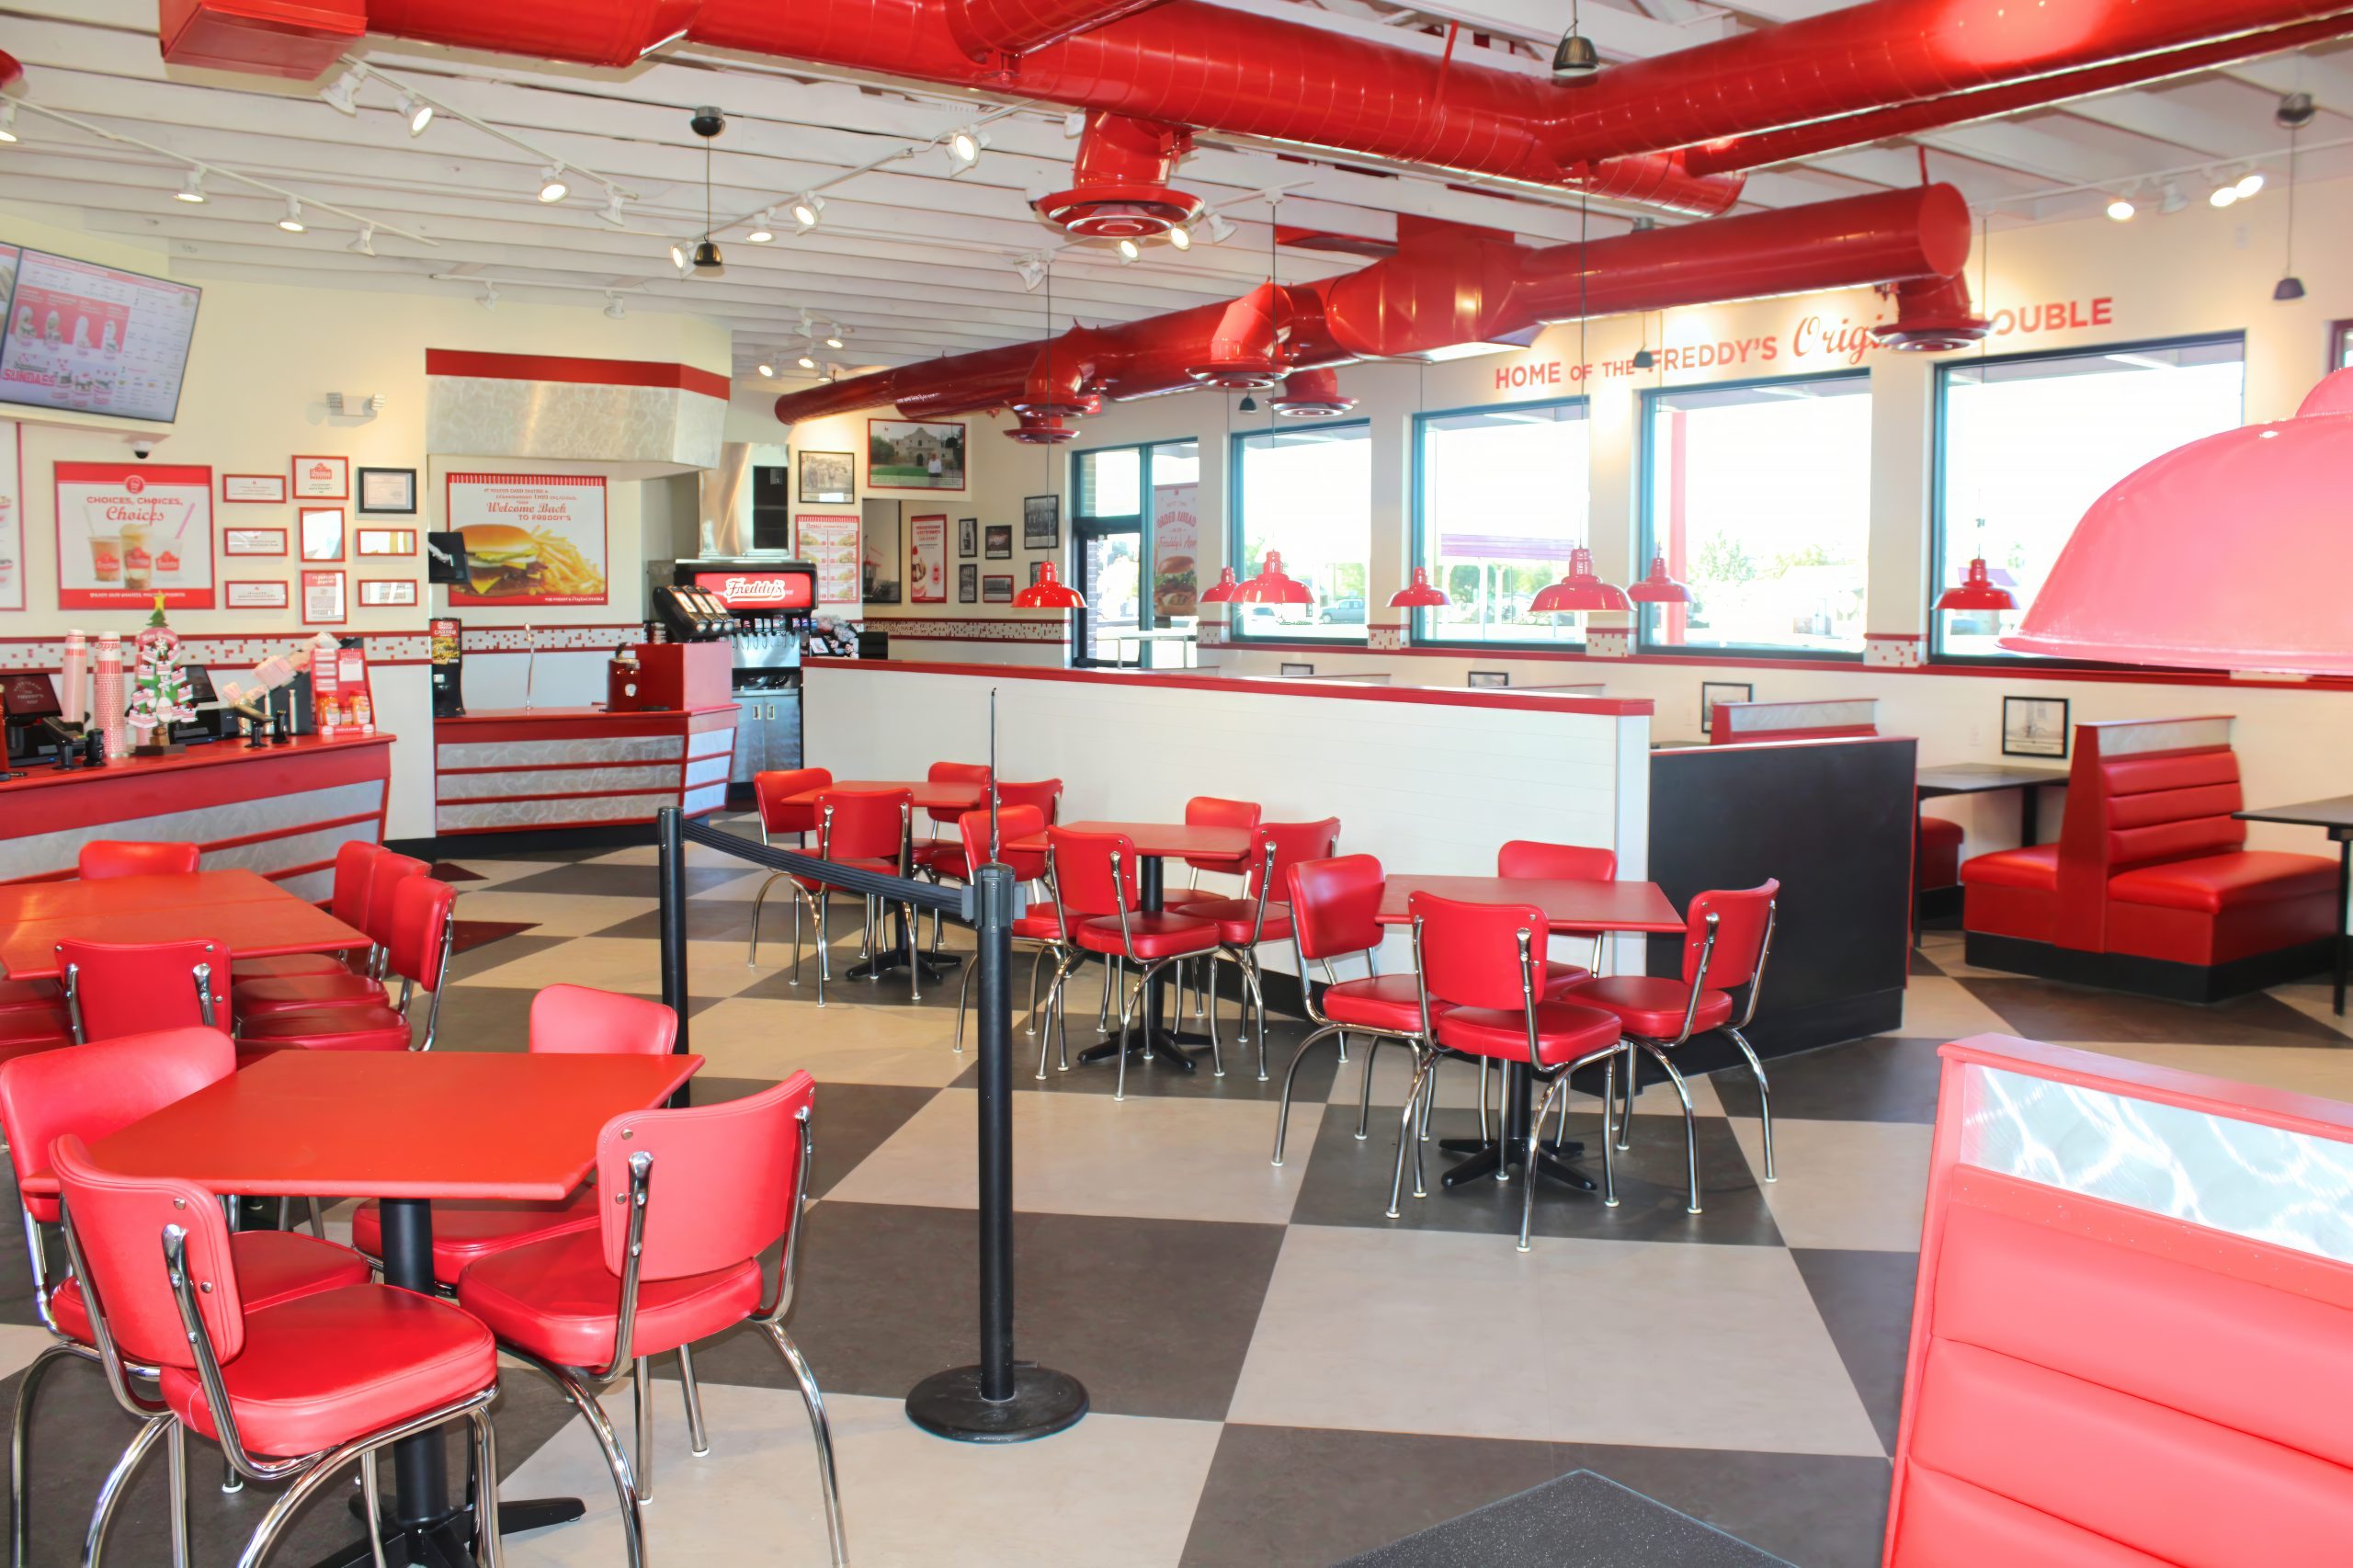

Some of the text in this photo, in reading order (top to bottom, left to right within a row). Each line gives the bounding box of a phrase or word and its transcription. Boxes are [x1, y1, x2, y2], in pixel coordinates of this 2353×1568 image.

[1495, 362, 1561, 390] HOME
[1570, 364, 1593, 381] OF
[1602, 359, 1635, 378] THE
[1792, 315, 1891, 365] Orig
[1972, 297, 2113, 336] OUBLE
[86, 496, 183, 506] CHOICES, CHOICES,
[486, 502, 567, 513] Welcome Back
[106, 506, 165, 521] Choices
[724, 579, 784, 599] Freddy's
